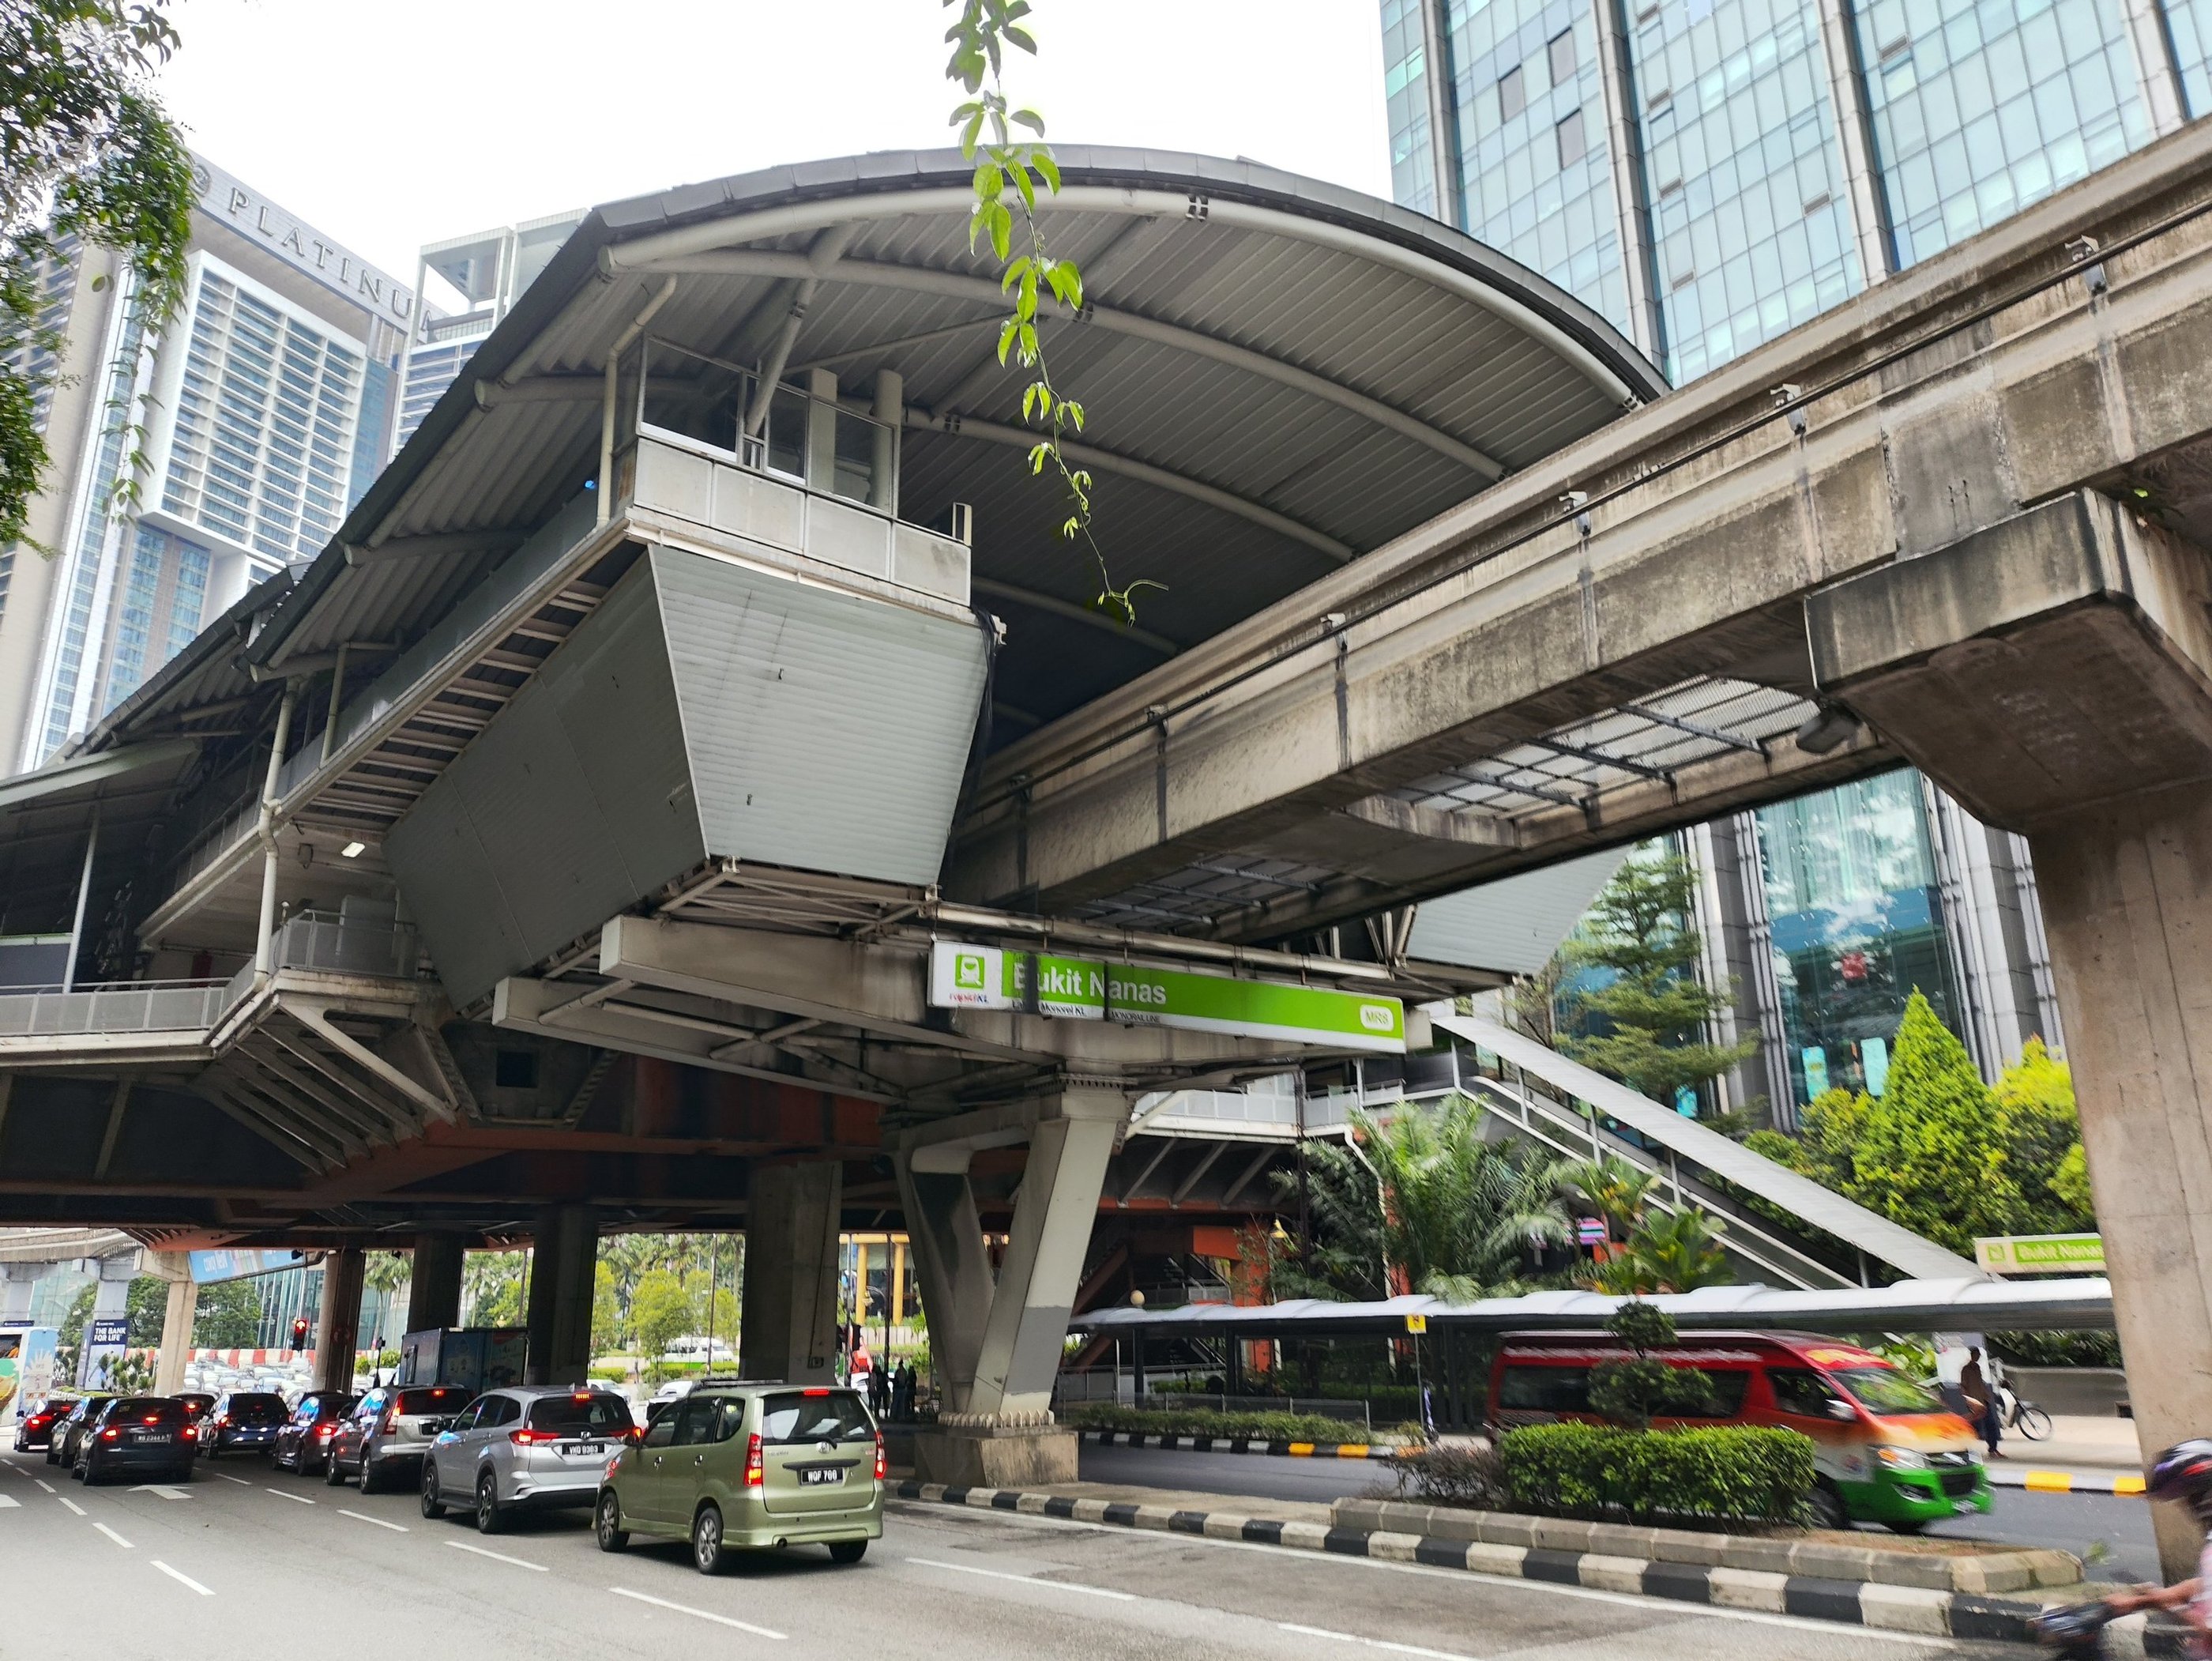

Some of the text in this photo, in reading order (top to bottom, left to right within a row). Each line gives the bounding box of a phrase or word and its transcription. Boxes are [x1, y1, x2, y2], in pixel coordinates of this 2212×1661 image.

[1014, 962, 1167, 1005] Bukit Nanas
[823, 1469, 837, 1481] 700
